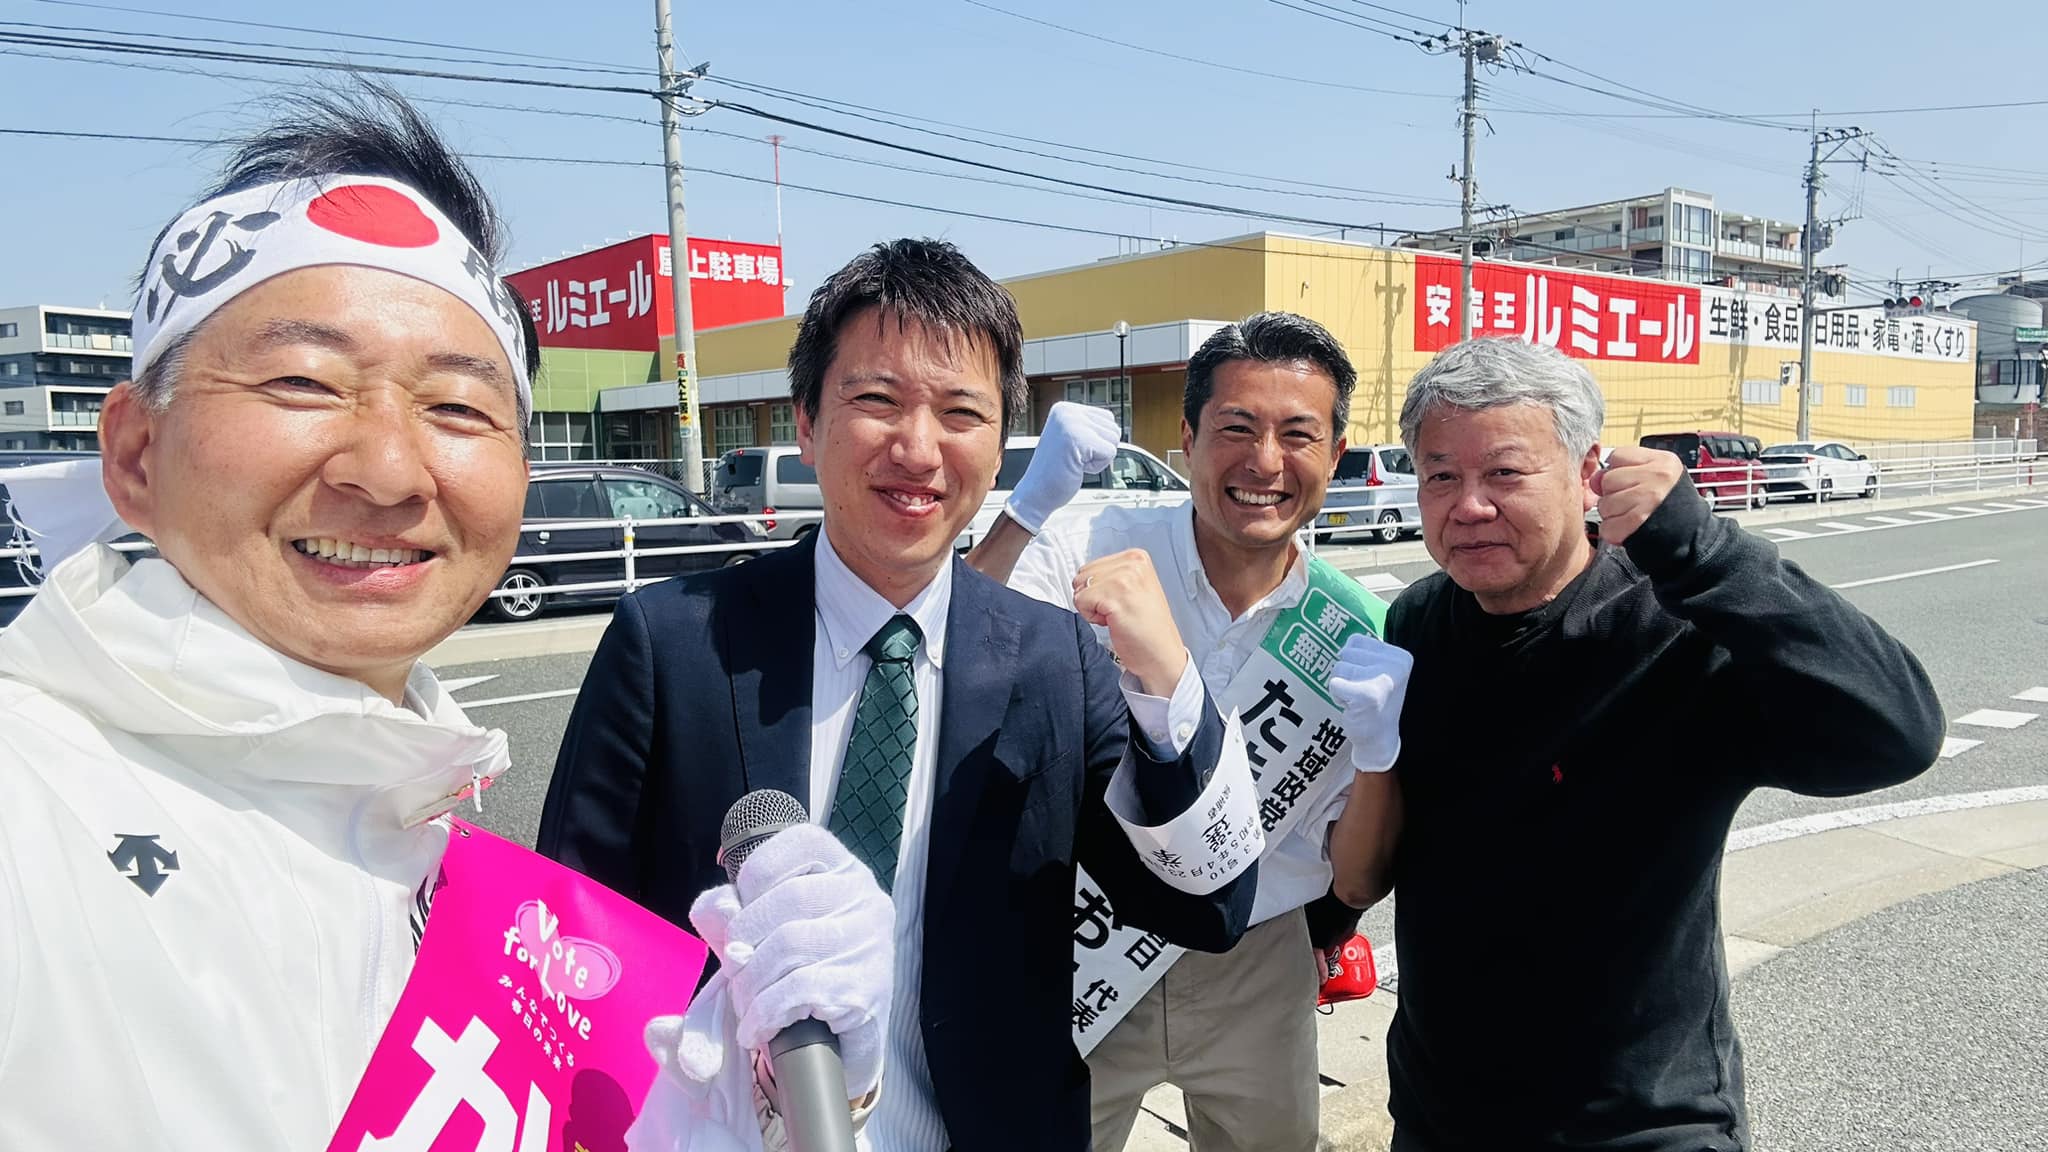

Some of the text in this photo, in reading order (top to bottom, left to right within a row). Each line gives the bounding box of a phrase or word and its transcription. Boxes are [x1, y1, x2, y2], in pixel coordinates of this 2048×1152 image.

[546, 259, 652, 335] ルミエール
[1522, 273, 1695, 359] ルミエール
[1259, 718, 1347, 833] 地域政党
[503, 926, 592, 1041] for Love
[537, 899, 589, 989] Vote
